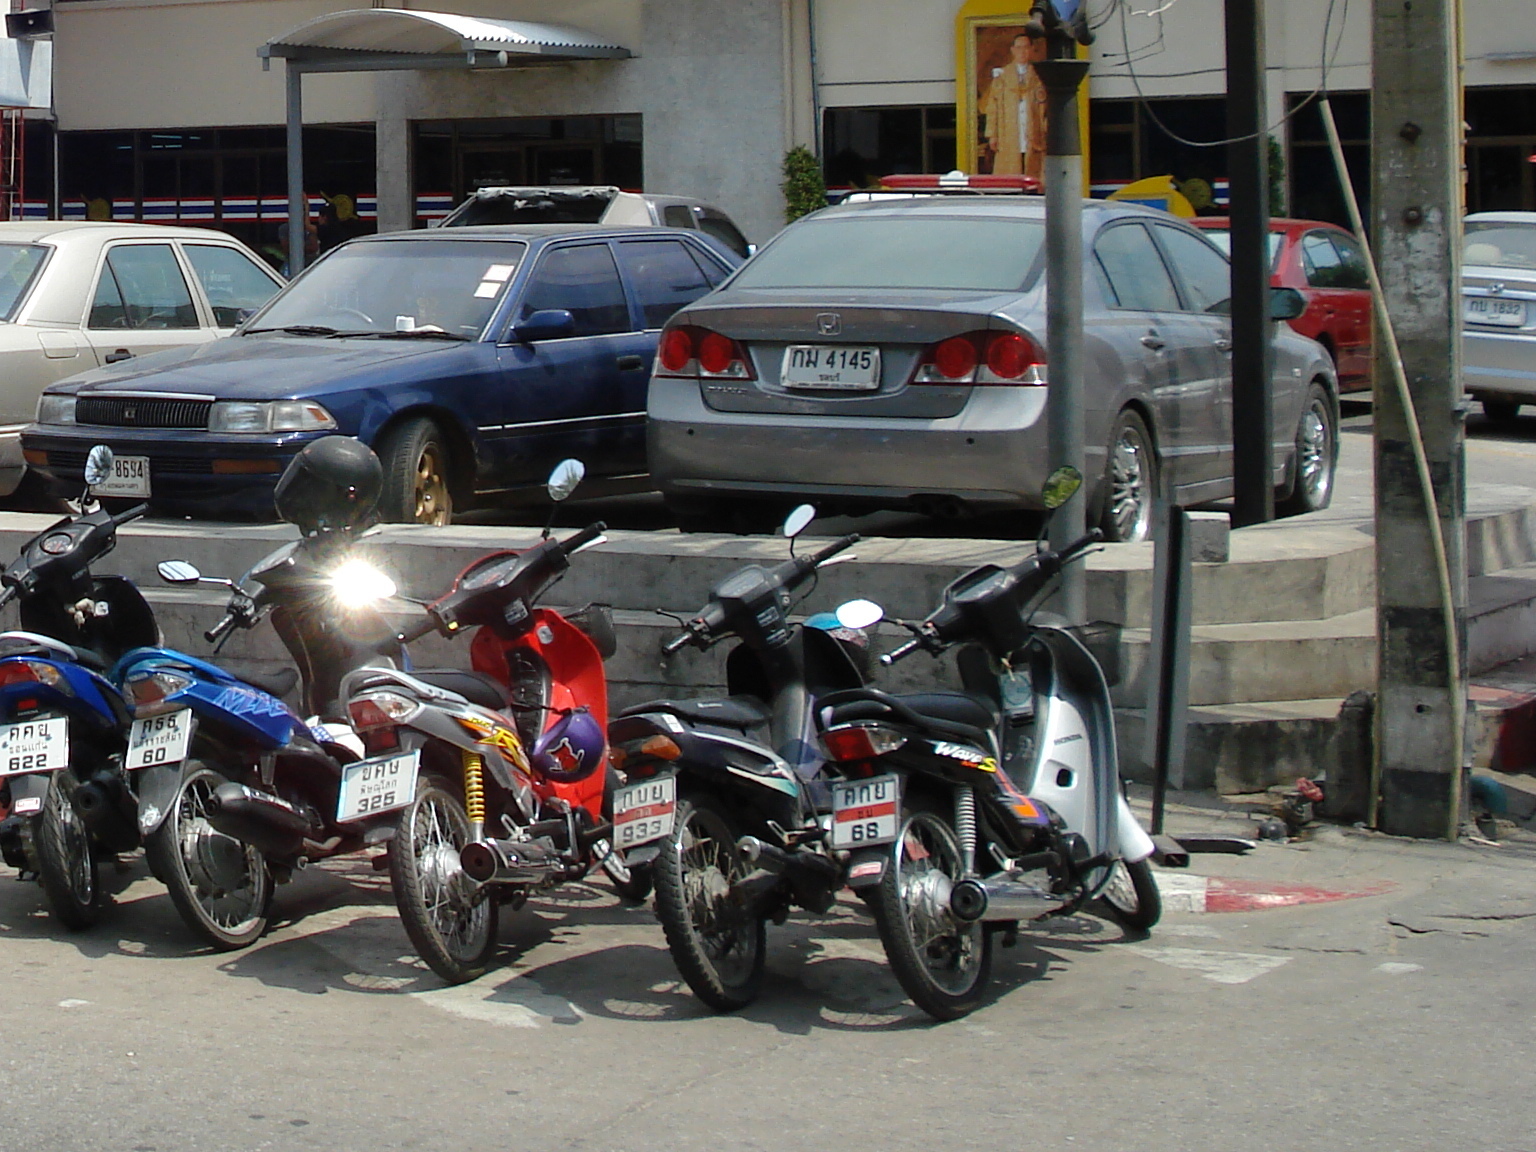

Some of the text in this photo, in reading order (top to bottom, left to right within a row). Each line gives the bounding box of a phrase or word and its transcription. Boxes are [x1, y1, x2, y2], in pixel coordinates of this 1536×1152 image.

[791, 349, 872, 370] กม 4145
[9, 753, 47, 771] 622
[143, 747, 166, 764] 60
[358, 791, 395, 813] 325
[623, 821, 662, 843] 933
